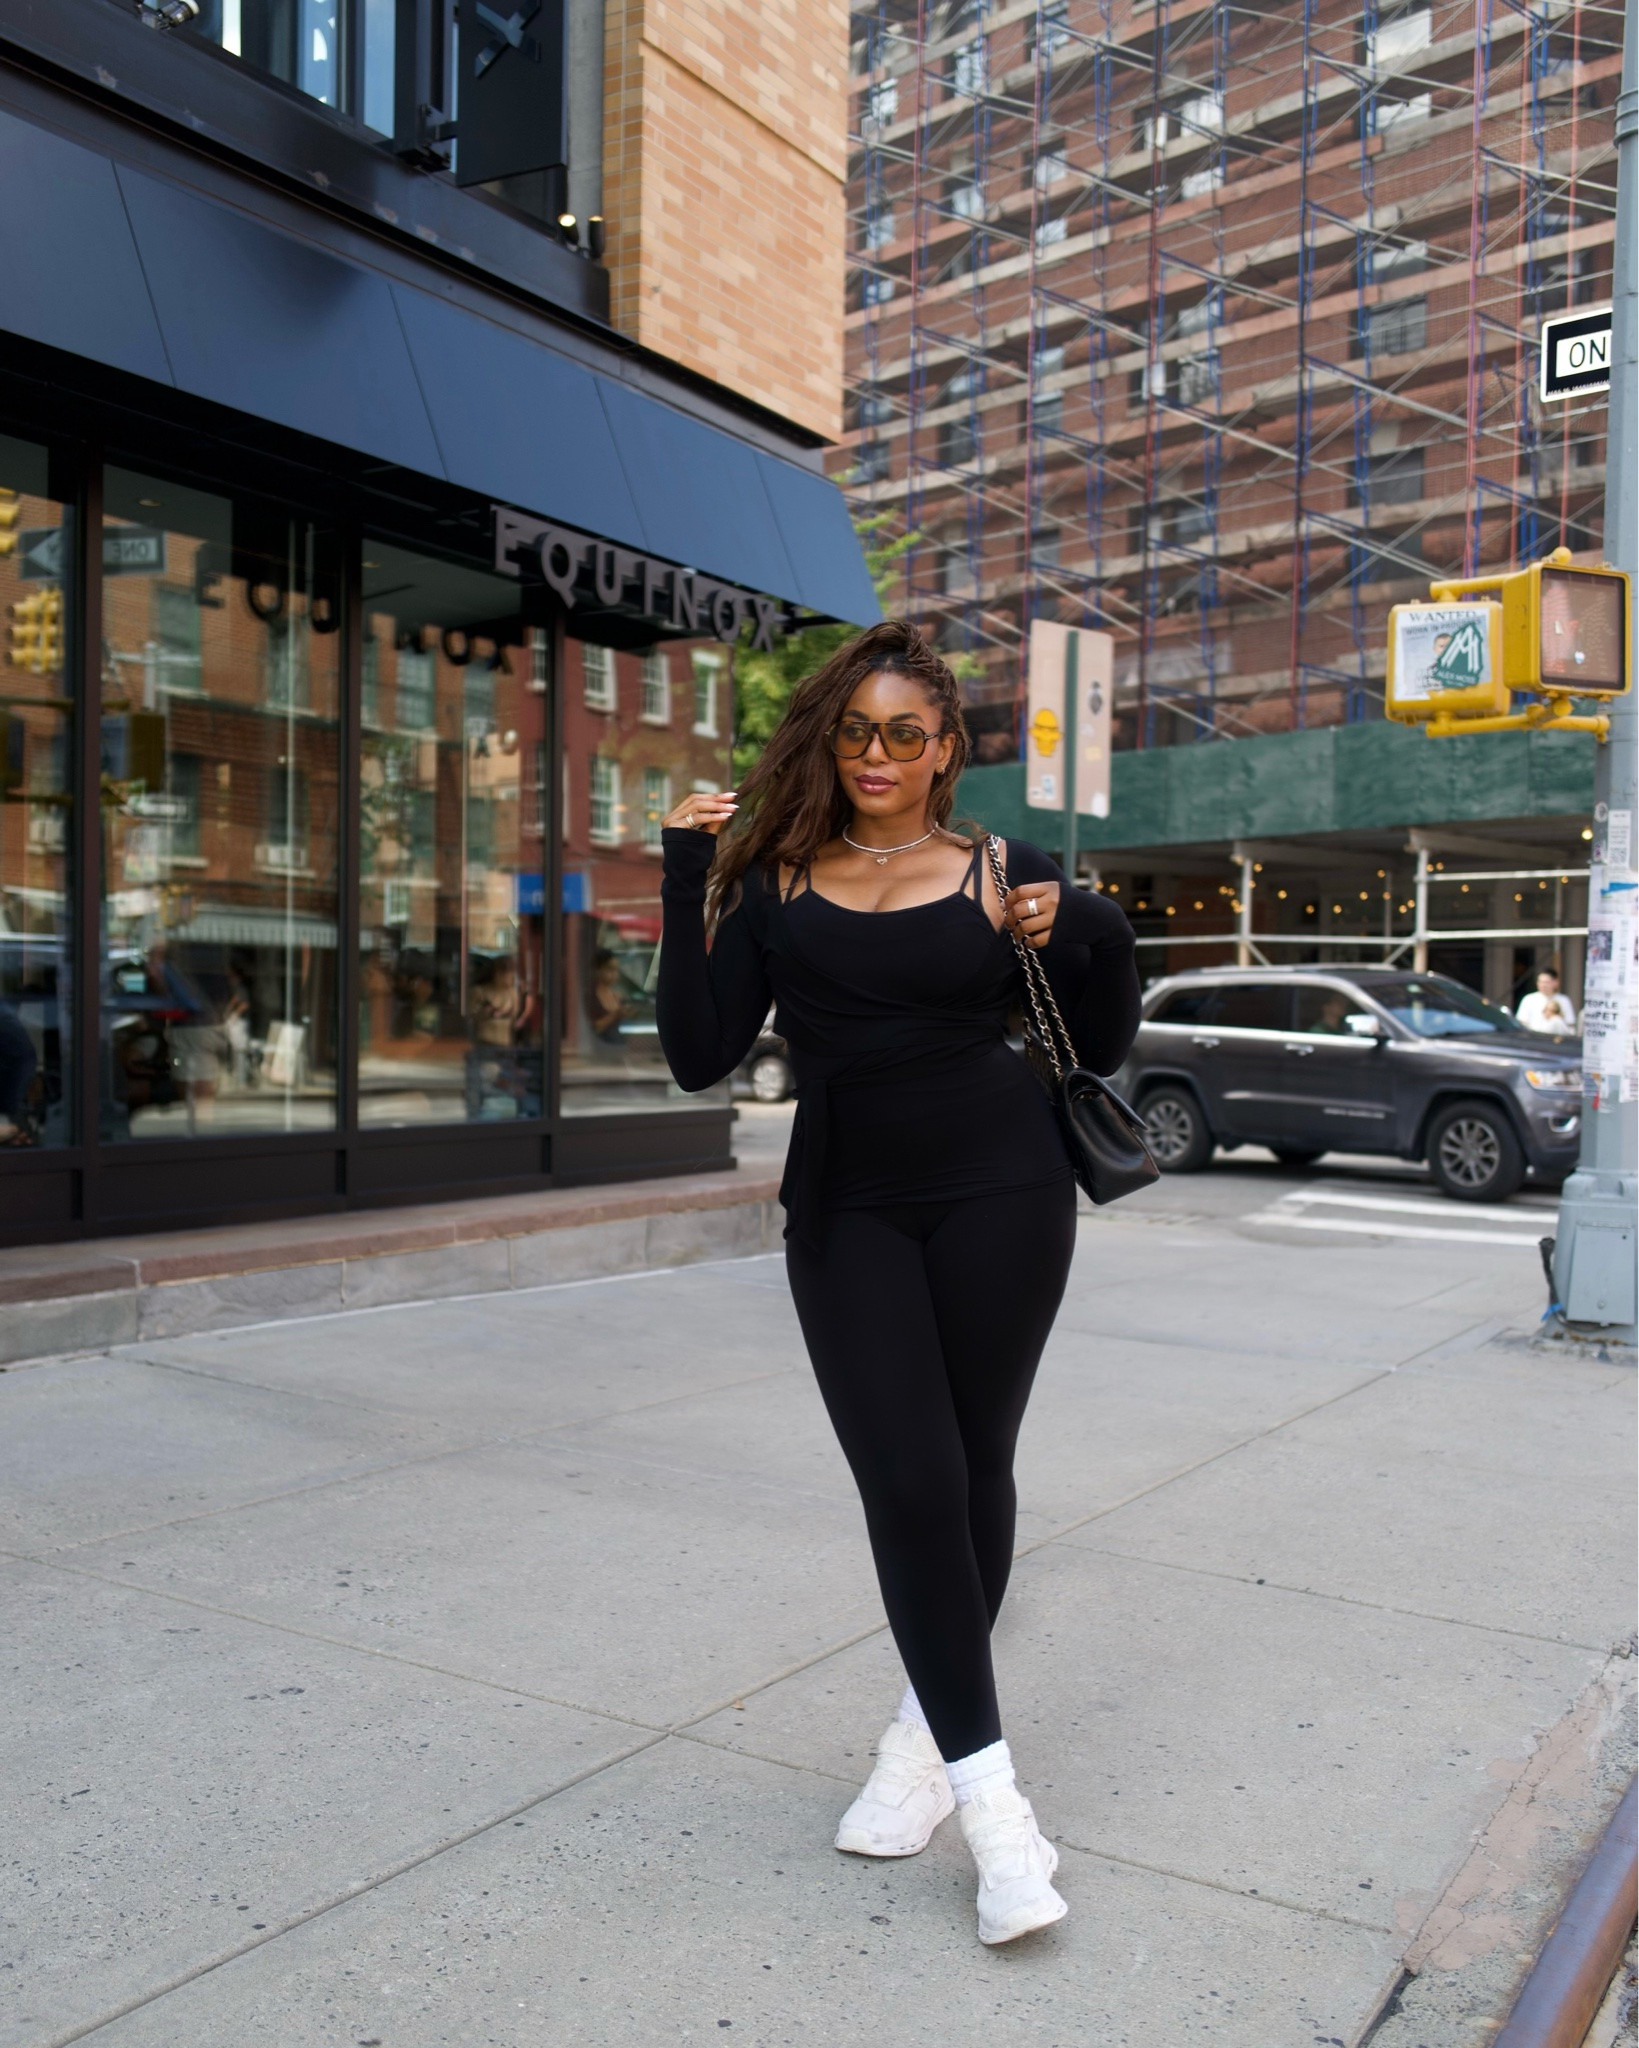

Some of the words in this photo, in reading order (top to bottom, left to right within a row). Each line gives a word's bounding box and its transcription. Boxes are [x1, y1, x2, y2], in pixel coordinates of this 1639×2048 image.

[1569, 336, 1606, 368] ON
[490, 505, 774, 652] EQUINOX
[1409, 611, 1477, 621] WANTED
